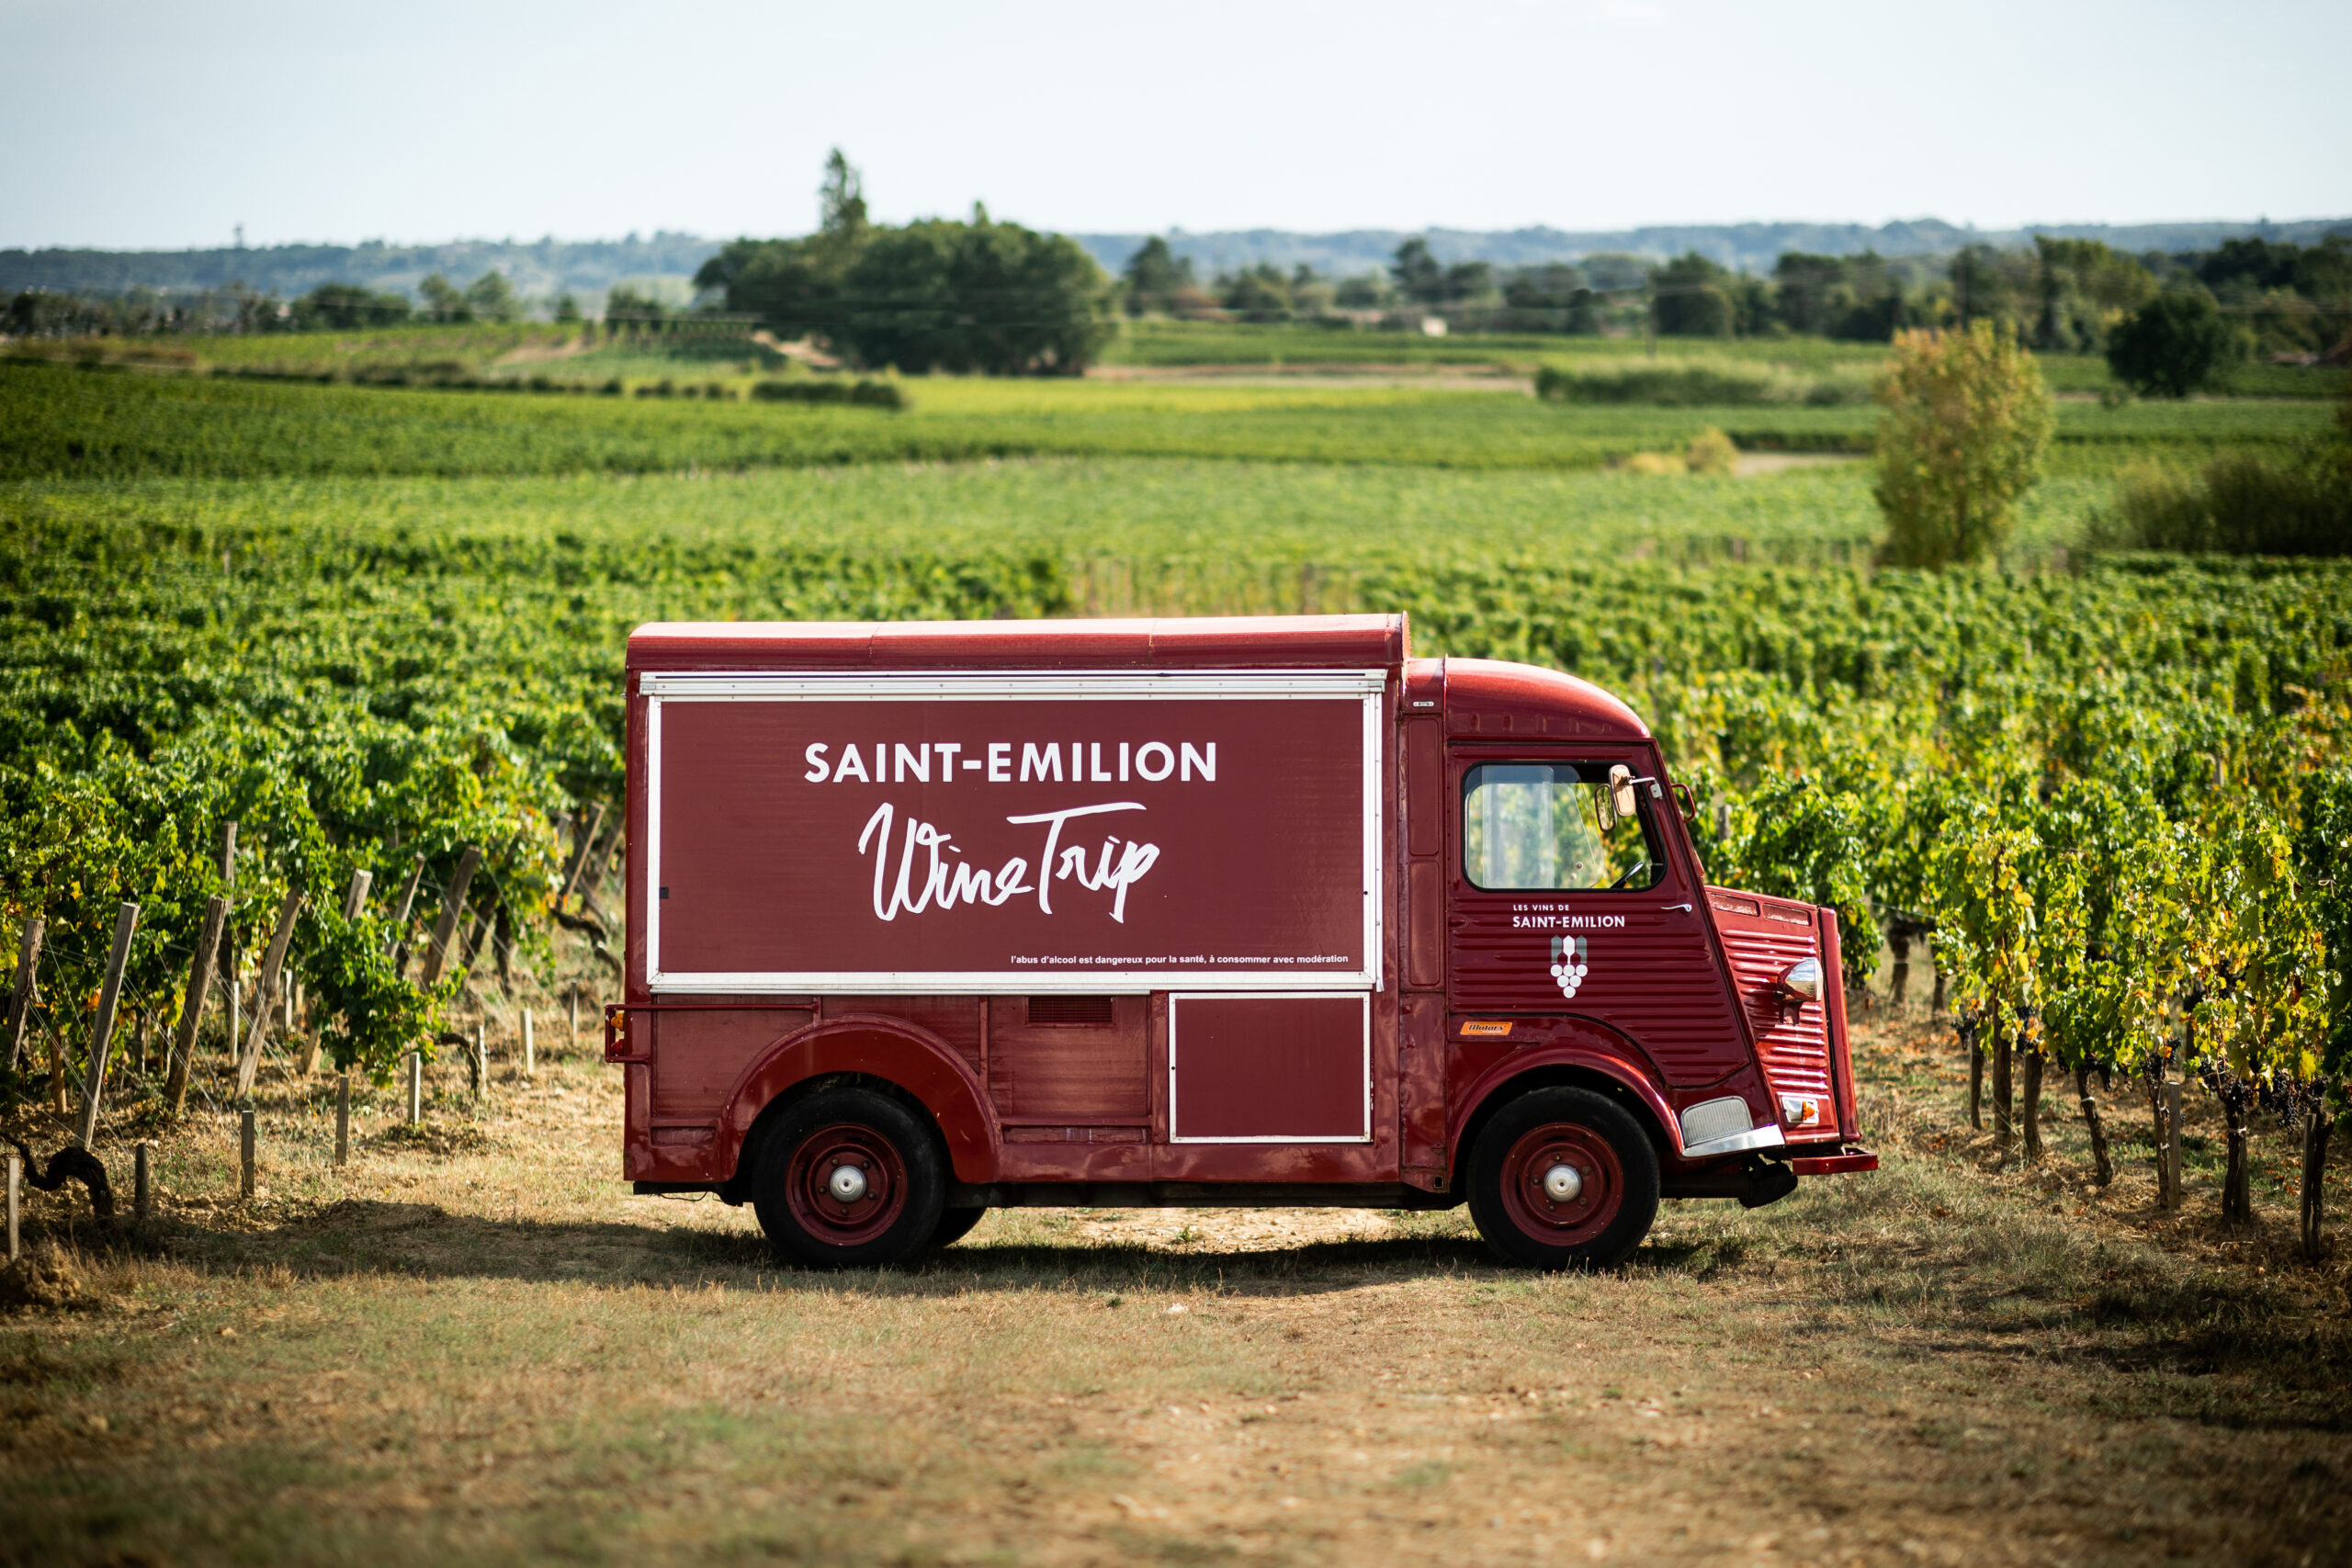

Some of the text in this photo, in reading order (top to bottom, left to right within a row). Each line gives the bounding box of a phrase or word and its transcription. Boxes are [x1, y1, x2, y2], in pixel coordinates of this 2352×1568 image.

[804, 741, 1216, 784] SAINT-EMILION
[857, 801, 1160, 924] Wine Trip
[1512, 915, 1625, 929] SAINT-EMILION
[1078, 955, 1093, 964] est
[1094, 954, 1144, 966] dangereux
[1145, 955, 1167, 966] pour
[1169, 954, 1178, 964] la
[1179, 954, 1207, 964] santé,
[1208, 954, 1216, 964] à
[1216, 955, 1272, 964] consommer
[1296, 954, 1349, 964] modération
